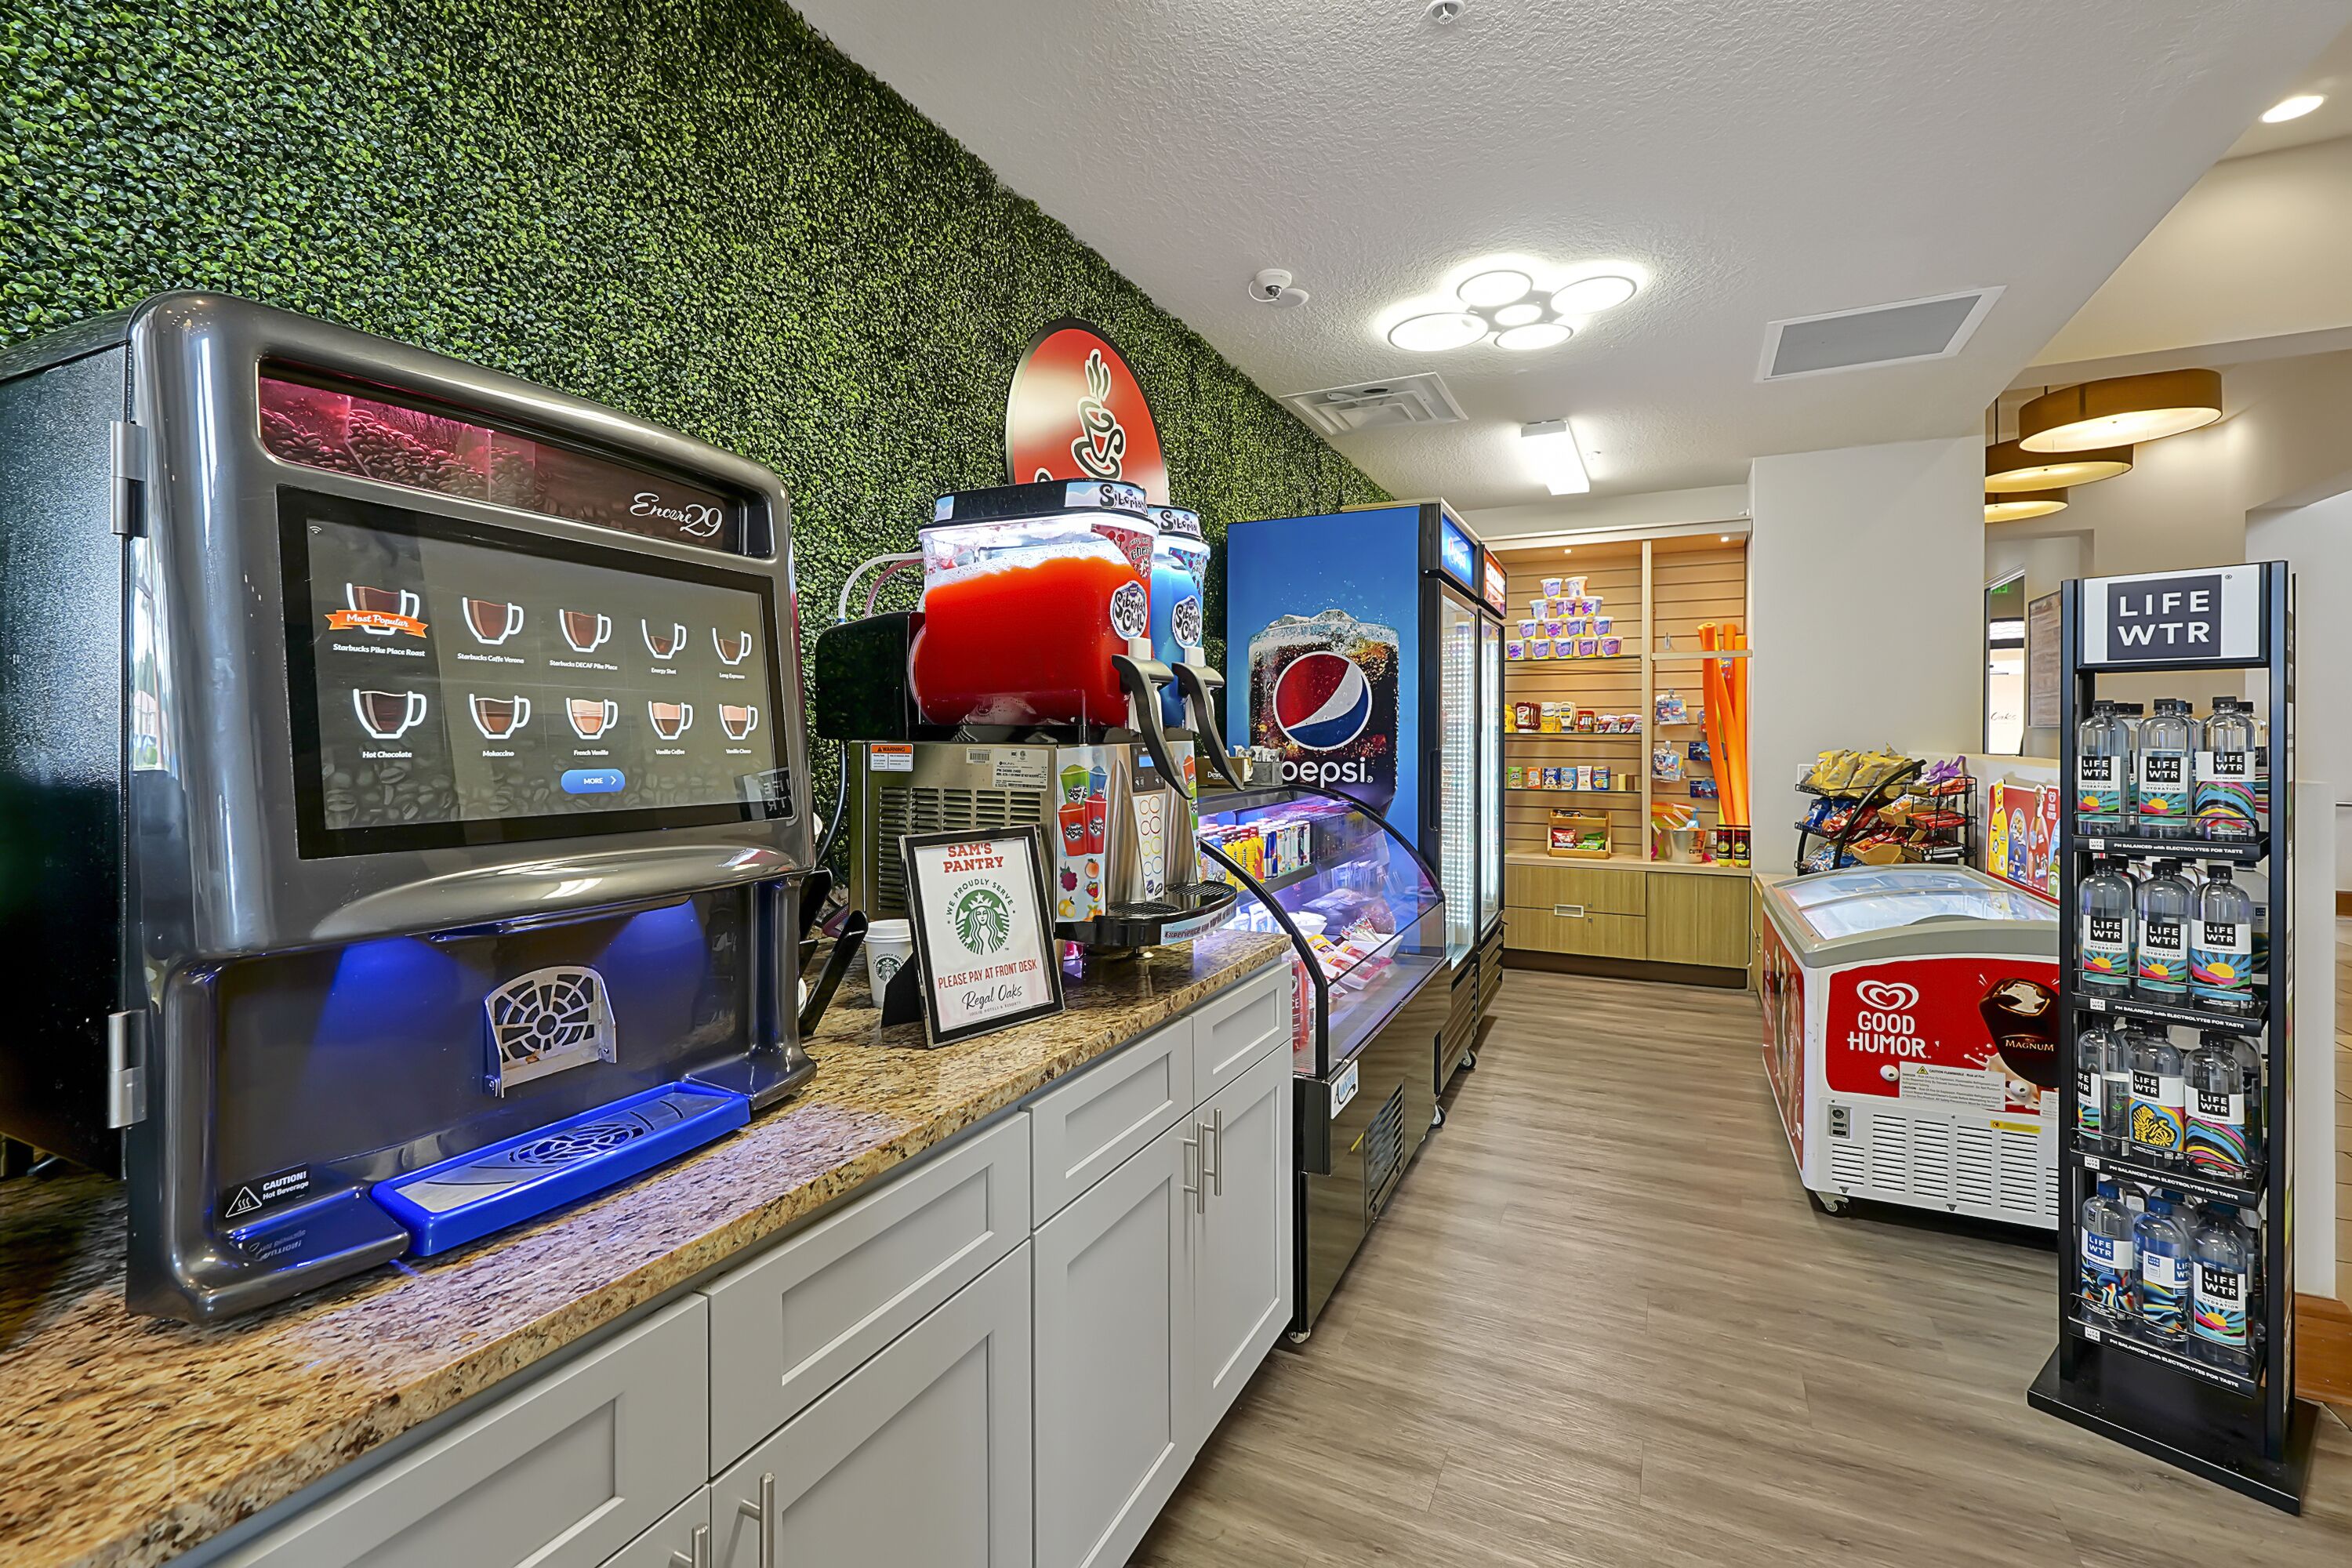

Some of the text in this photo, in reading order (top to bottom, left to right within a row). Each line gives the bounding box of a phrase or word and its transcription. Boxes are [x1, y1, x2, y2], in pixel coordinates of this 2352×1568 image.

[1160, 510, 1198, 532] Siberia
[2119, 590, 2210, 617] LIFE
[346, 613, 409, 628] Most Popular
[2117, 621, 2210, 647] WTR
[333, 644, 426, 657] Starbucks Pike Place Roast
[457, 653, 488, 662] Starbucks
[549, 659, 575, 668] Starbucks
[362, 750, 412, 759] Hot Chocolate
[482, 750, 515, 758] Mokaccino
[2082, 760, 2109, 768] LIFE
[2148, 760, 2179, 769] LIFE
[2216, 764, 2243, 772] WTR
[2082, 768, 2109, 777] WTR
[2148, 770, 2179, 779] WTR
[947, 843, 993, 858] SAM'S
[942, 856, 1004, 873] PANTRY
[946, 878, 1014, 916] WE PROUDLY SERVE
[2092, 920, 2121, 930] LIFE
[2149, 925, 2179, 936] LIFE
[2206, 925, 2234, 935] LIFE
[2092, 929, 2121, 940] WTR
[2148, 935, 2179, 946] WTR
[2206, 933, 2234, 943] WTR
[938, 959, 1038, 989] PLEASE PAY AT FRONT DESK
[961, 983, 1023, 1011] Regal Oaks
[2123, 1007, 2154, 1015] BALANCED
[2166, 1012, 2211, 1024] ELECTROLYTES
[1857, 1011, 1915, 1035] GOOD
[1847, 1032, 1927, 1058] HUMOR
[2005, 1039, 2054, 1052] MAGNUM
[2078, 1073, 2089, 1083] IFE
[2134, 1074, 2158, 1087] LIFE
[2134, 1083, 2158, 1094] WTR
[2200, 1094, 2227, 1105] LIFE
[2200, 1102, 2227, 1114] WTR
[263, 1171, 307, 1192] CAUTION!
[2118, 1167, 2148, 1179] BALANCED
[2161, 1176, 2205, 1192] ELECTROLYTES
[2205, 1187, 2219, 1196] FOR
[2219, 1190, 2238, 1200] TASTE
[263, 1181, 310, 1200] Hot Beverage
[2089, 1236, 2111, 1248] LIFE
[2089, 1243, 2112, 1258] WTR
[2176, 1270, 2189, 1279] WT
[2205, 1272, 2236, 1287] LIFE
[2204, 1282, 2236, 1297] WTR
[2118, 1341, 2149, 1356] BALANCED
[2149, 1352, 2161, 1360] with
[2161, 1356, 2206, 1377] ELECTROLYTES
[2206, 1371, 2220, 1381] FOR
[2220, 1376, 2239, 1388] TASTE
